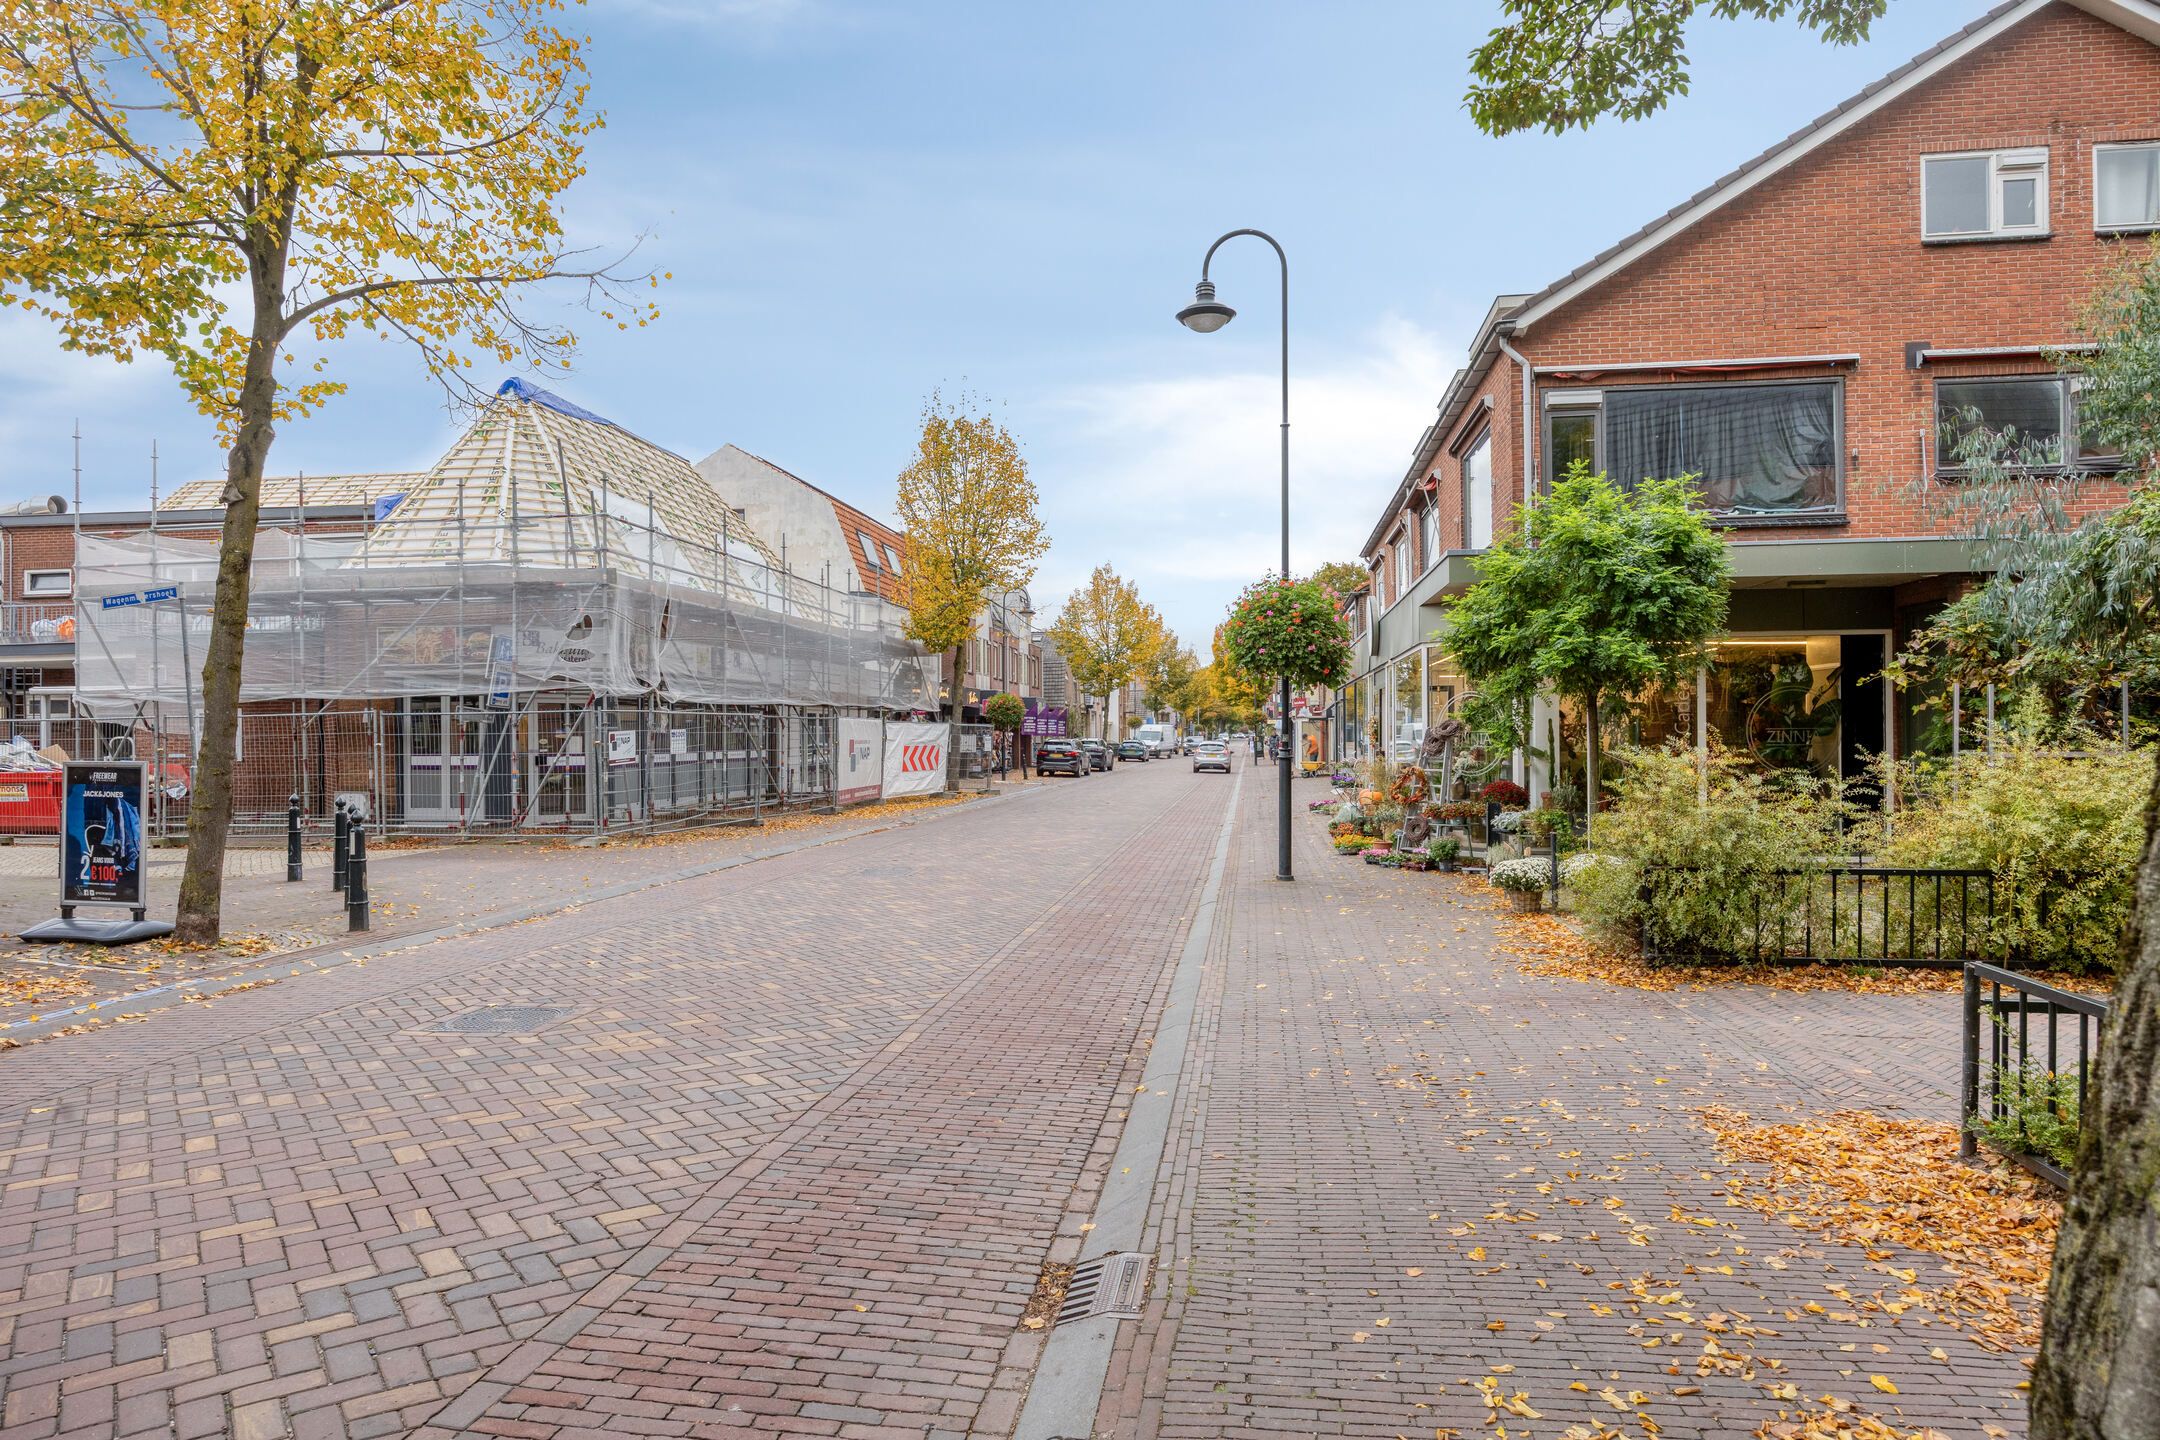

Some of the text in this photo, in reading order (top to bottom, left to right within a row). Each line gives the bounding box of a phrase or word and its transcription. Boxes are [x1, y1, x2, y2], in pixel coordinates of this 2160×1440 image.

[105, 589, 174, 605] Wagenmershoek
[93, 772, 117, 780] FREEWEAR
[83, 790, 124, 798] JACK&JONES
[80, 855, 90, 880] 2
